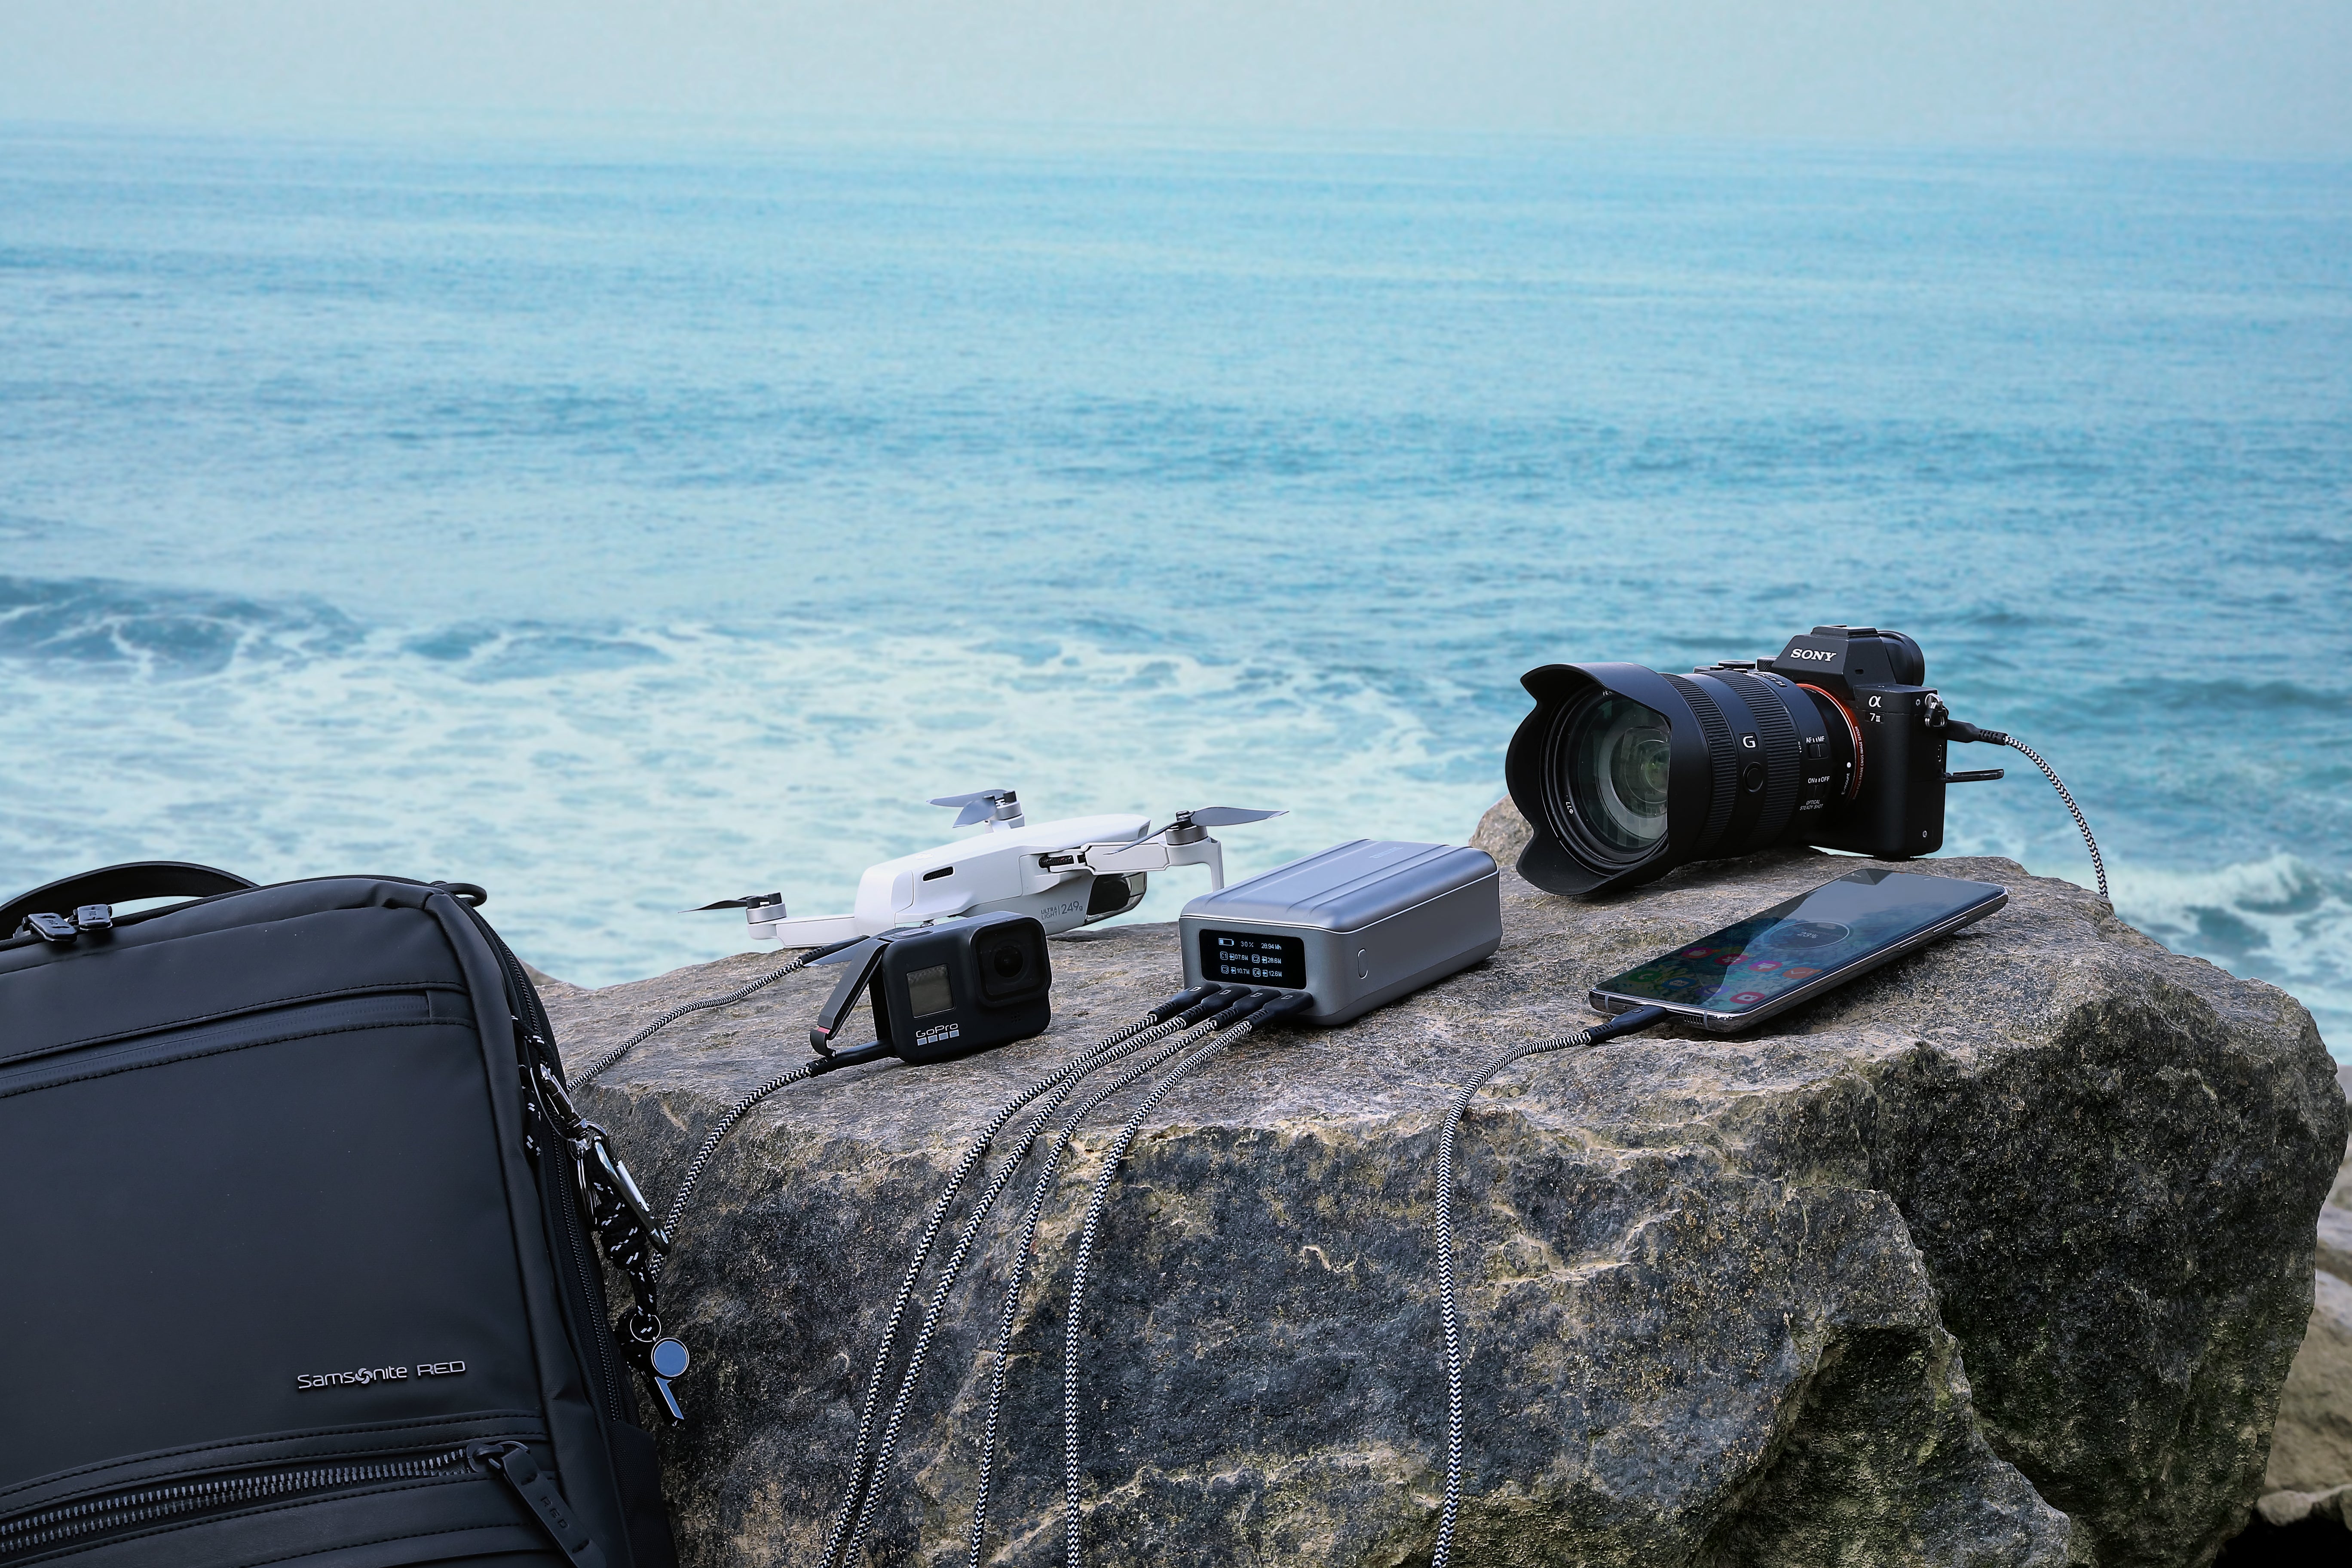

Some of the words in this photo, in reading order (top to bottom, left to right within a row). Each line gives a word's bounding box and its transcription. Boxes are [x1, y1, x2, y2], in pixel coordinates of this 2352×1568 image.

[1790, 648, 1837, 662] SONY
[1743, 736, 1756, 748] G
[1841, 773, 1850, 795] E-mount
[1061, 901, 1083, 914] 249g
[1041, 911, 1057, 920] LIGHT
[916, 1023, 958, 1038] GoPro
[297, 1366, 407, 1389] Samsonite
[416, 1360, 466, 1375] RED
[540, 1496, 569, 1528] RED
